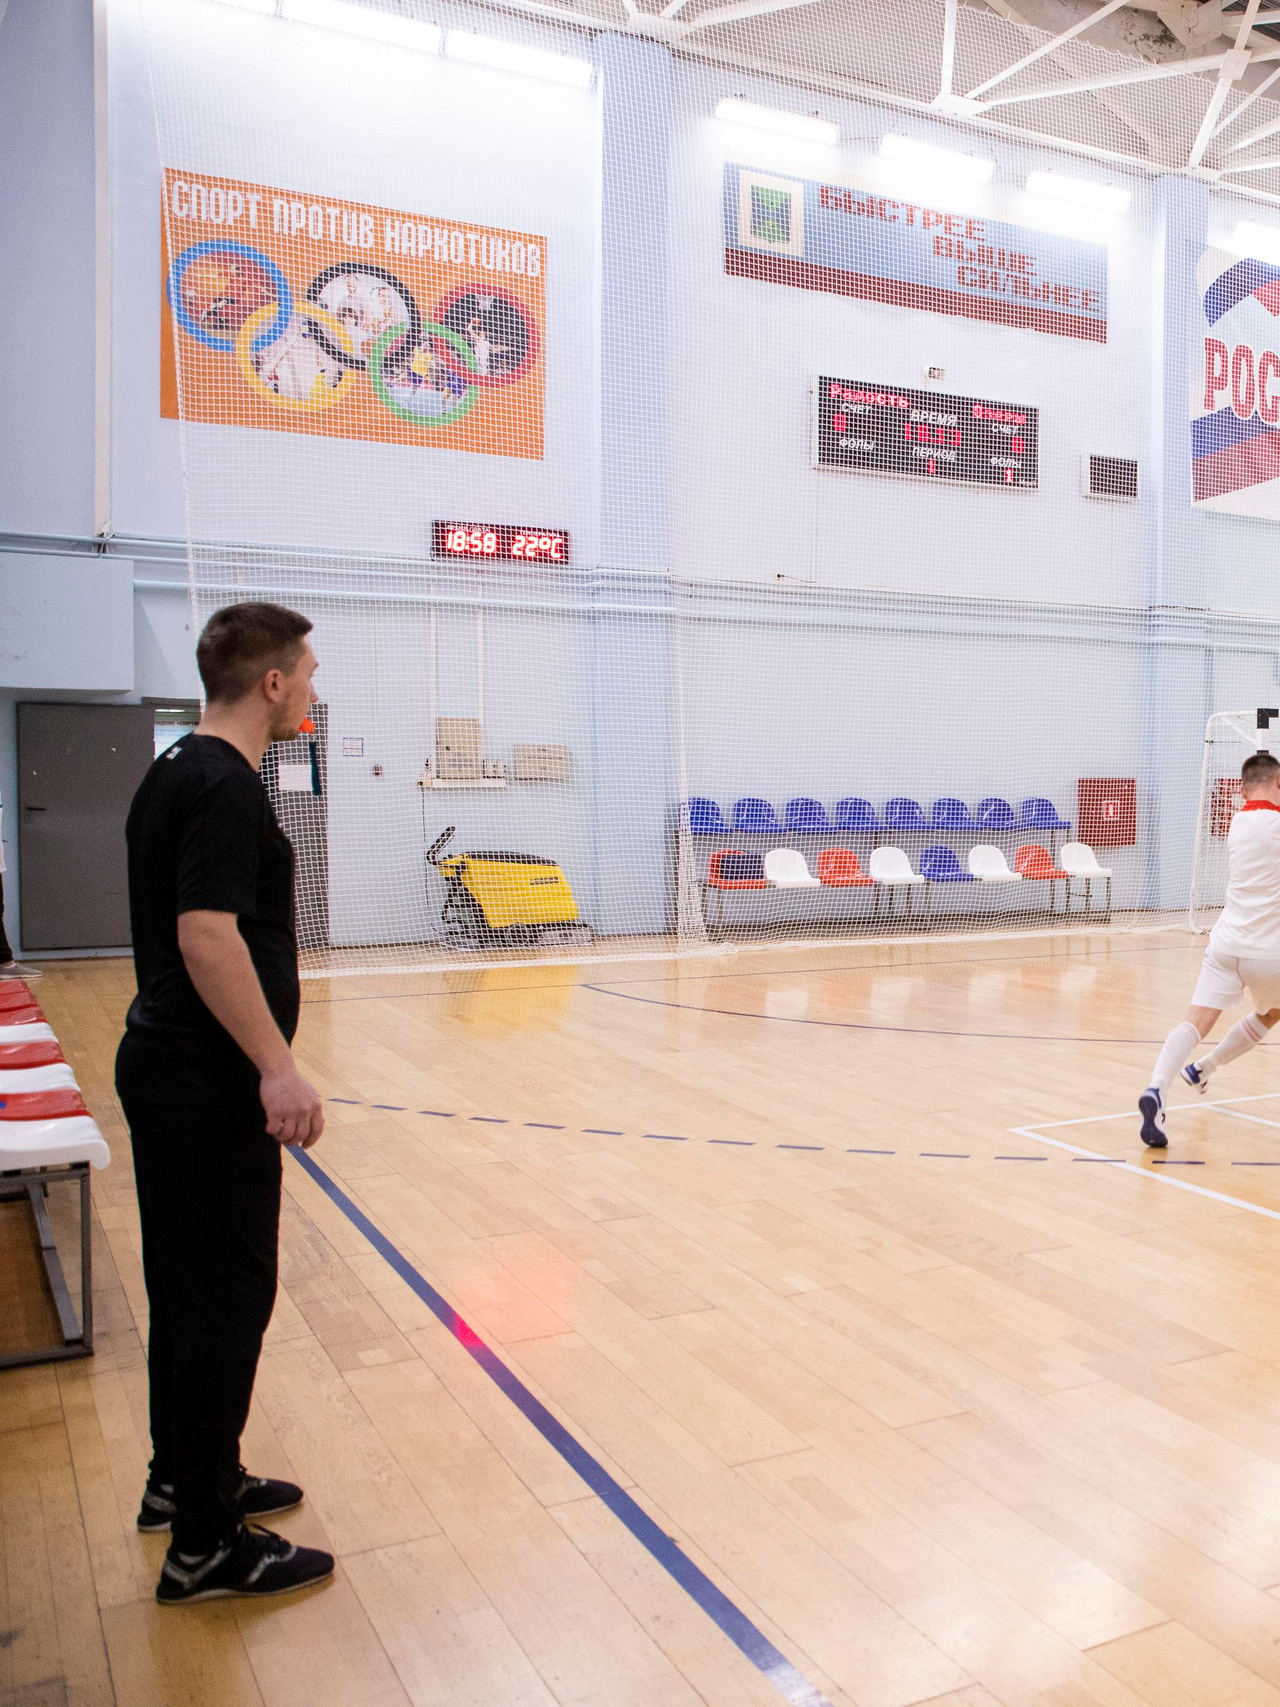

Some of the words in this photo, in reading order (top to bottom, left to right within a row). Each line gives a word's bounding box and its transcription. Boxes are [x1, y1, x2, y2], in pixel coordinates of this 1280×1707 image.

[819, 185, 988, 242] БЫСТРЕЕ
[171, 180, 263, 230] СПОРТ
[273, 199, 375, 249] ПРОТИВ
[385, 217, 541, 277] НАРКОТИКОВ
[932, 235, 1038, 276] ВЫШЕ
[957, 266, 1101, 313] СИЛЬНЕЕ
[841, 402, 872, 415] СЧЕТ
[911, 408, 957, 427] ВРЕМЯ
[991, 423, 1019, 436] СЧЕТ
[839, 438, 875, 451] ФОЛЫ
[912, 447, 957, 463] ПЕРИОД
[990, 456, 1022, 468] ФОЛЫ
[1004, 467, 1013, 483] 1
[446, 530, 497, 553] 18:58
